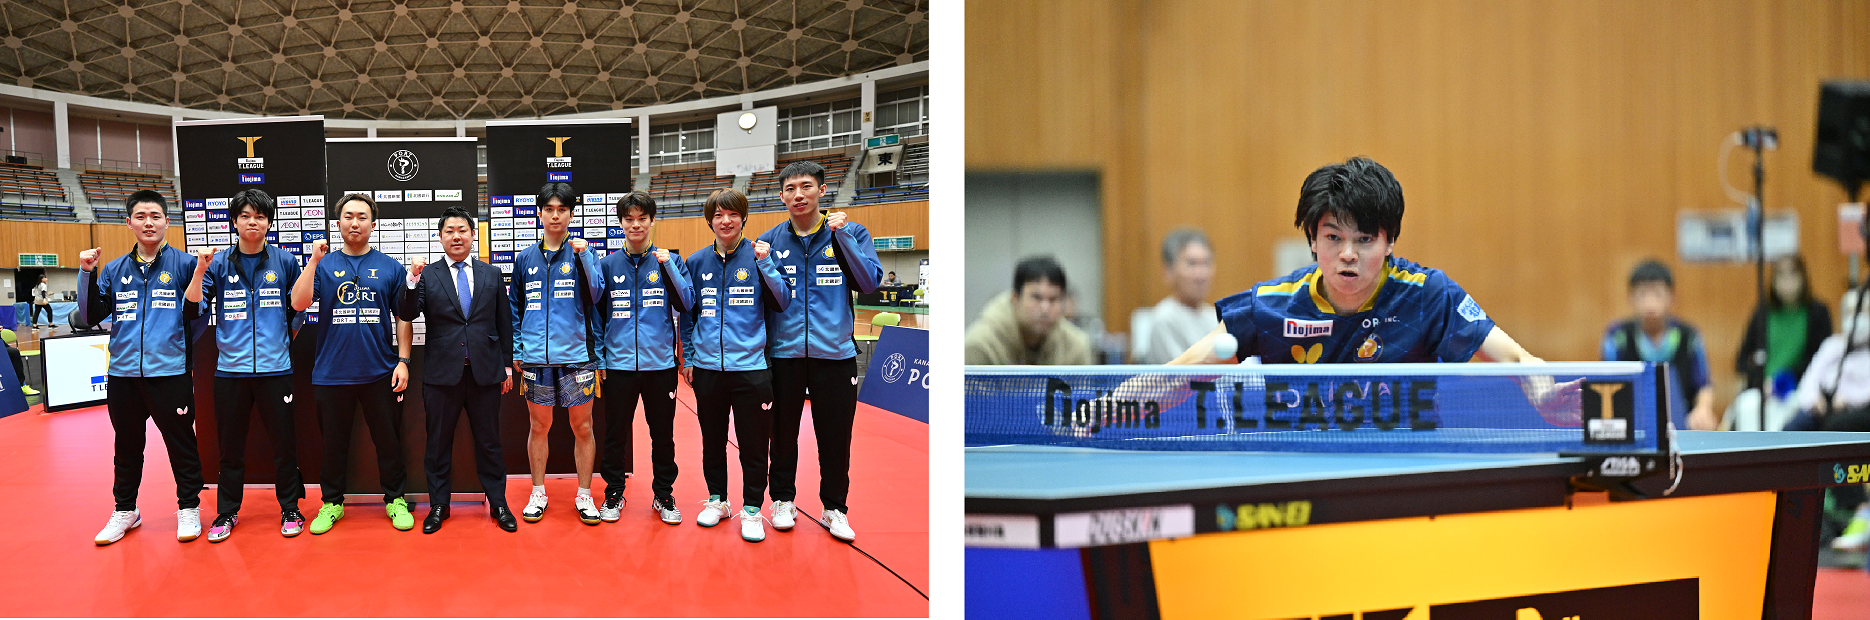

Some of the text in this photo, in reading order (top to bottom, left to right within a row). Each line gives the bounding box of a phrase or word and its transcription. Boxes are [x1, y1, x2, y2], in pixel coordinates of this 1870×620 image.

[877, 152, 893, 166] 東
[347, 291, 377, 302] PORT
[1190, 380, 1437, 433] T.LEAGUE
